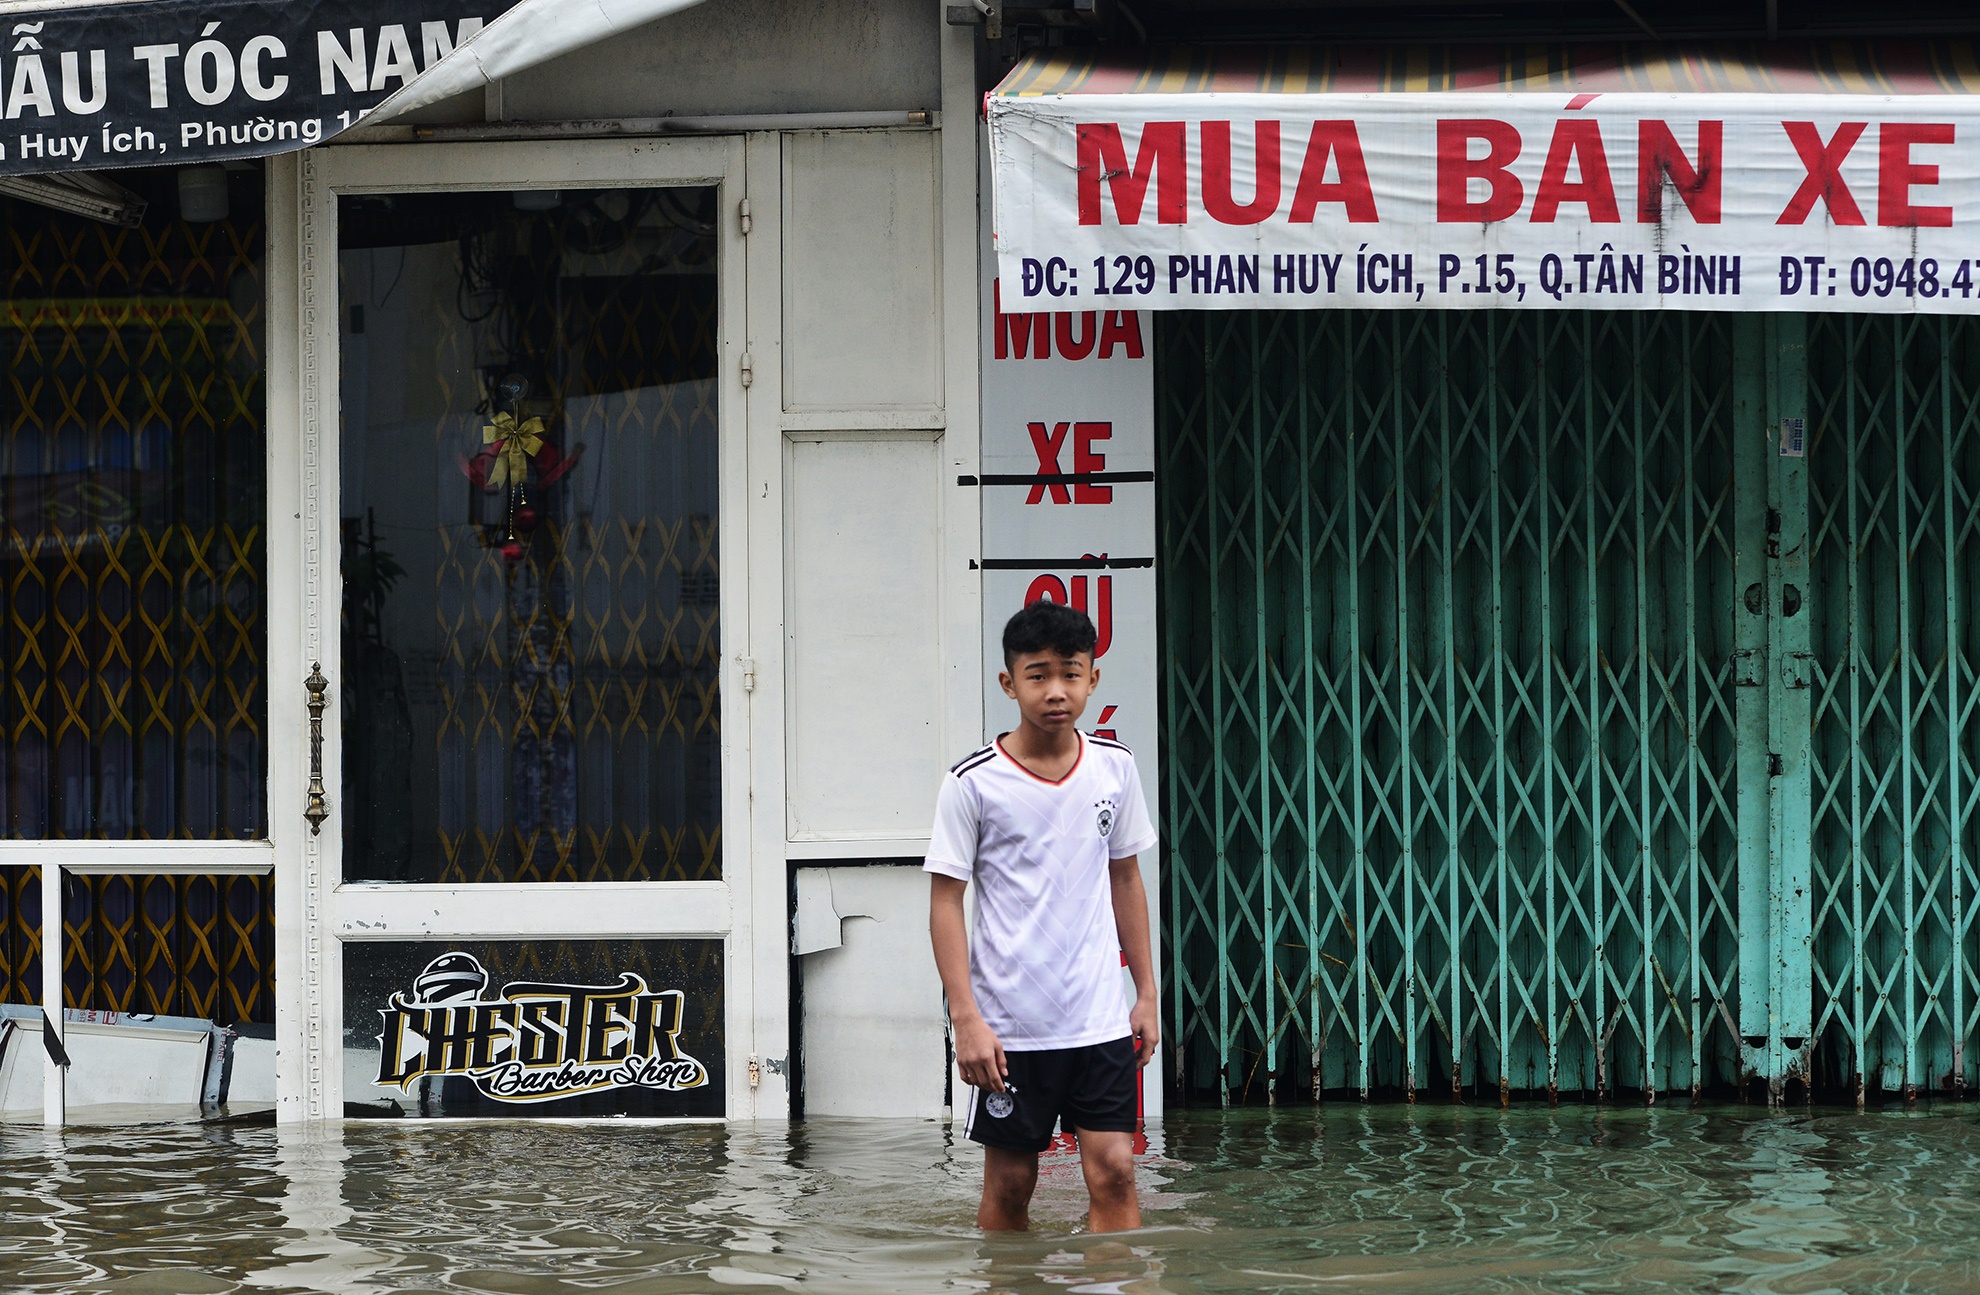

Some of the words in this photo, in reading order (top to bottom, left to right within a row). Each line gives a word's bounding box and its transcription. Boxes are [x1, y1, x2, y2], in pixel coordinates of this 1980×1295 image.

[0, 22, 107, 119] ẪU
[134, 22, 289, 108] TÓC
[20, 133, 89, 162] Huy
[103, 122, 167, 154] Ích,
[181, 116, 322, 148] Phường
[1076, 119, 1380, 226] MUA
[1436, 94, 1724, 224] BÁN
[1775, 121, 1956, 228] XE
[1021, 256, 1078, 297] ĐC:
[1093, 254, 1156, 296] 129
[1168, 254, 1260, 294] PHAN
[1273, 253, 1344, 295] HUY
[1356, 243, 1425, 303] ÍCH,
[1439, 253, 1526, 302] P.15,
[1539, 243, 1644, 302] Q.TÂN
[1658, 244, 1741, 295] BÌNH
[1778, 255, 1837, 296] ĐT:
[1850, 256, 1980, 298] 0948.4
[1025, 422, 1113, 505] XE
[374, 974, 686, 1095] CHESTER
[468, 1060, 607, 1094] Barber
[611, 1055, 702, 1090] Shop
